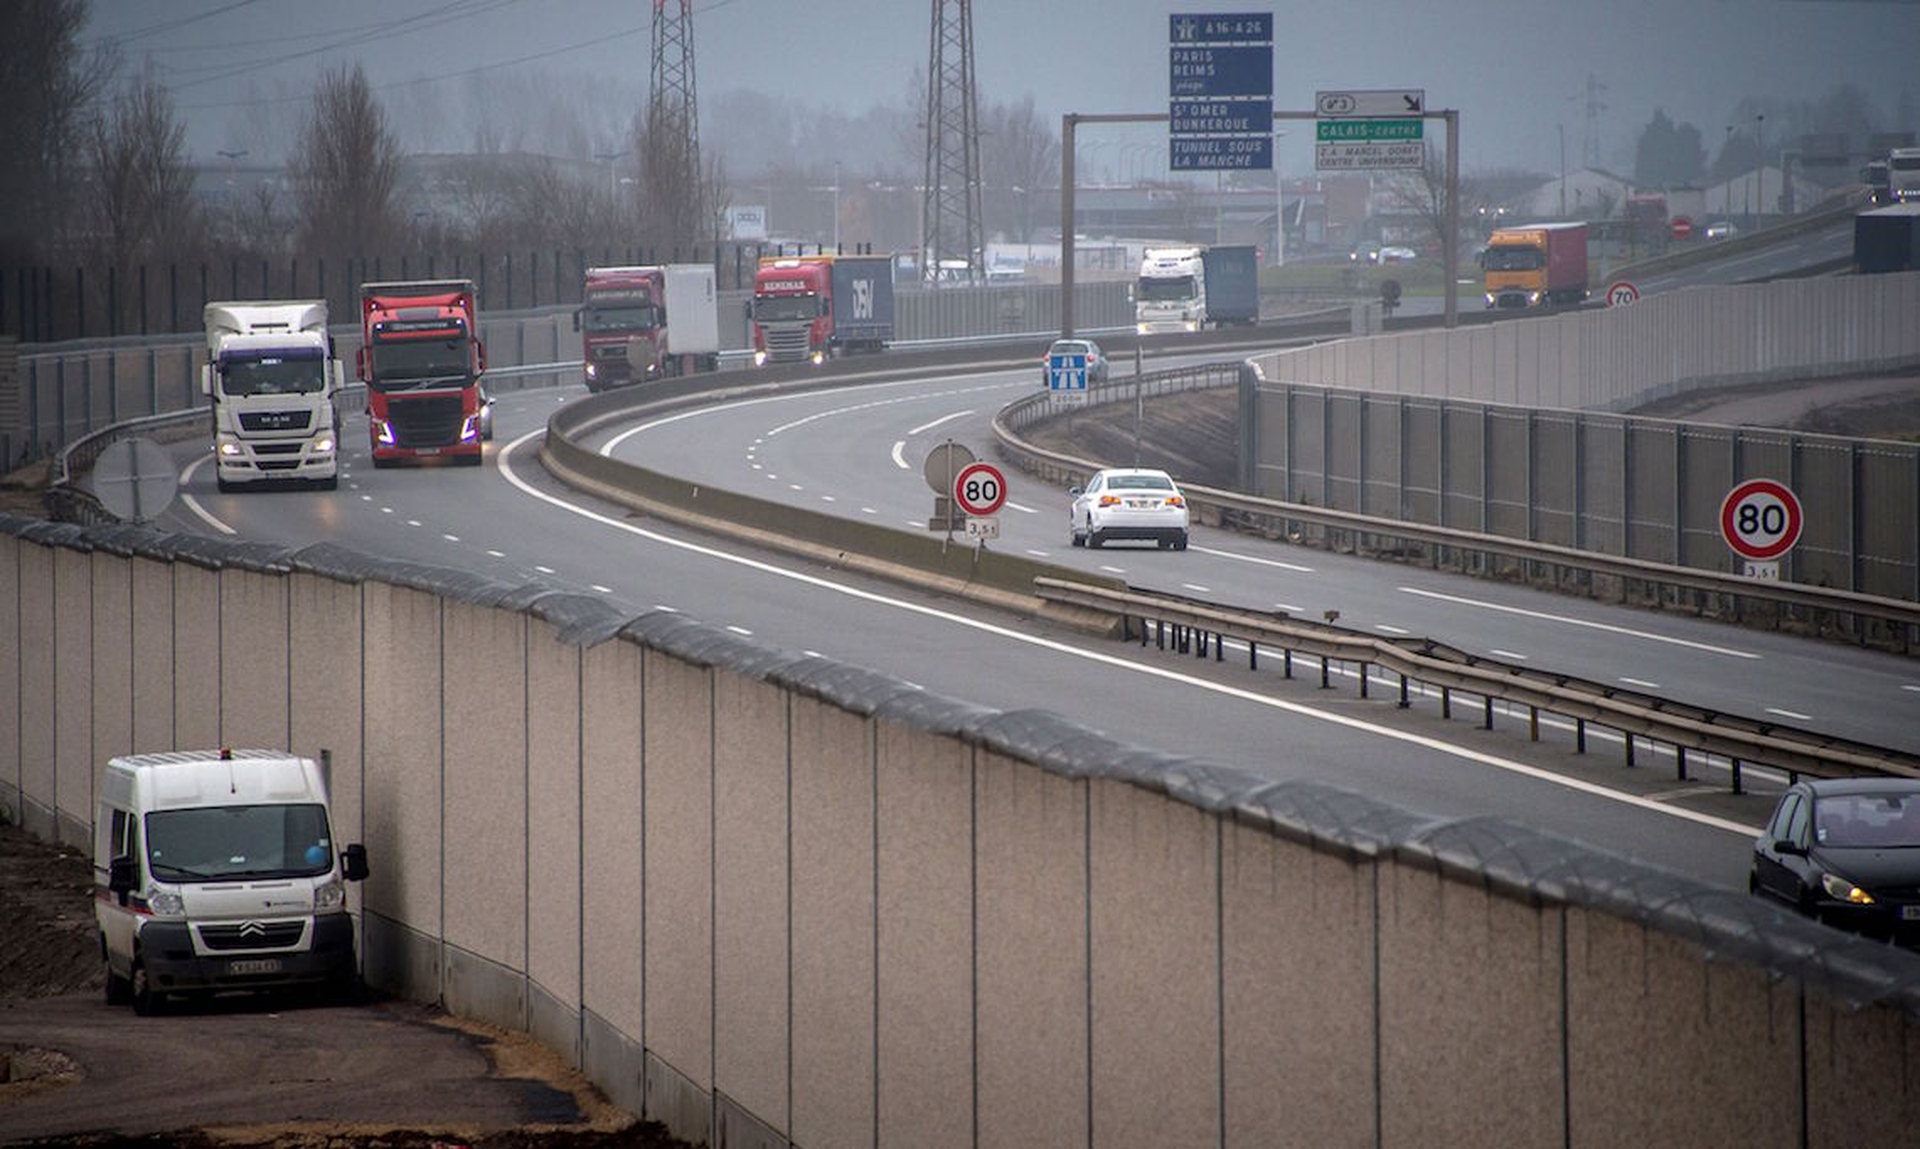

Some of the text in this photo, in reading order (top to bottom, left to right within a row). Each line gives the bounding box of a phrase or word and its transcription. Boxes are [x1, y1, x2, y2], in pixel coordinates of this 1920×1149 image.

[1173, 51, 1213, 62] PARIS
[1173, 64, 1215, 76] REIMS
[1190, 104, 1228, 116] OMER
[1174, 119, 1250, 131] DUNKERQUE
[1174, 140, 1263, 153] TUNNEL SOUS
[1174, 155, 1253, 167] LA MANCHE
[1615, 291, 1633, 304] 70
[966, 480, 997, 501] 80
[1739, 504, 1785, 535] 80
